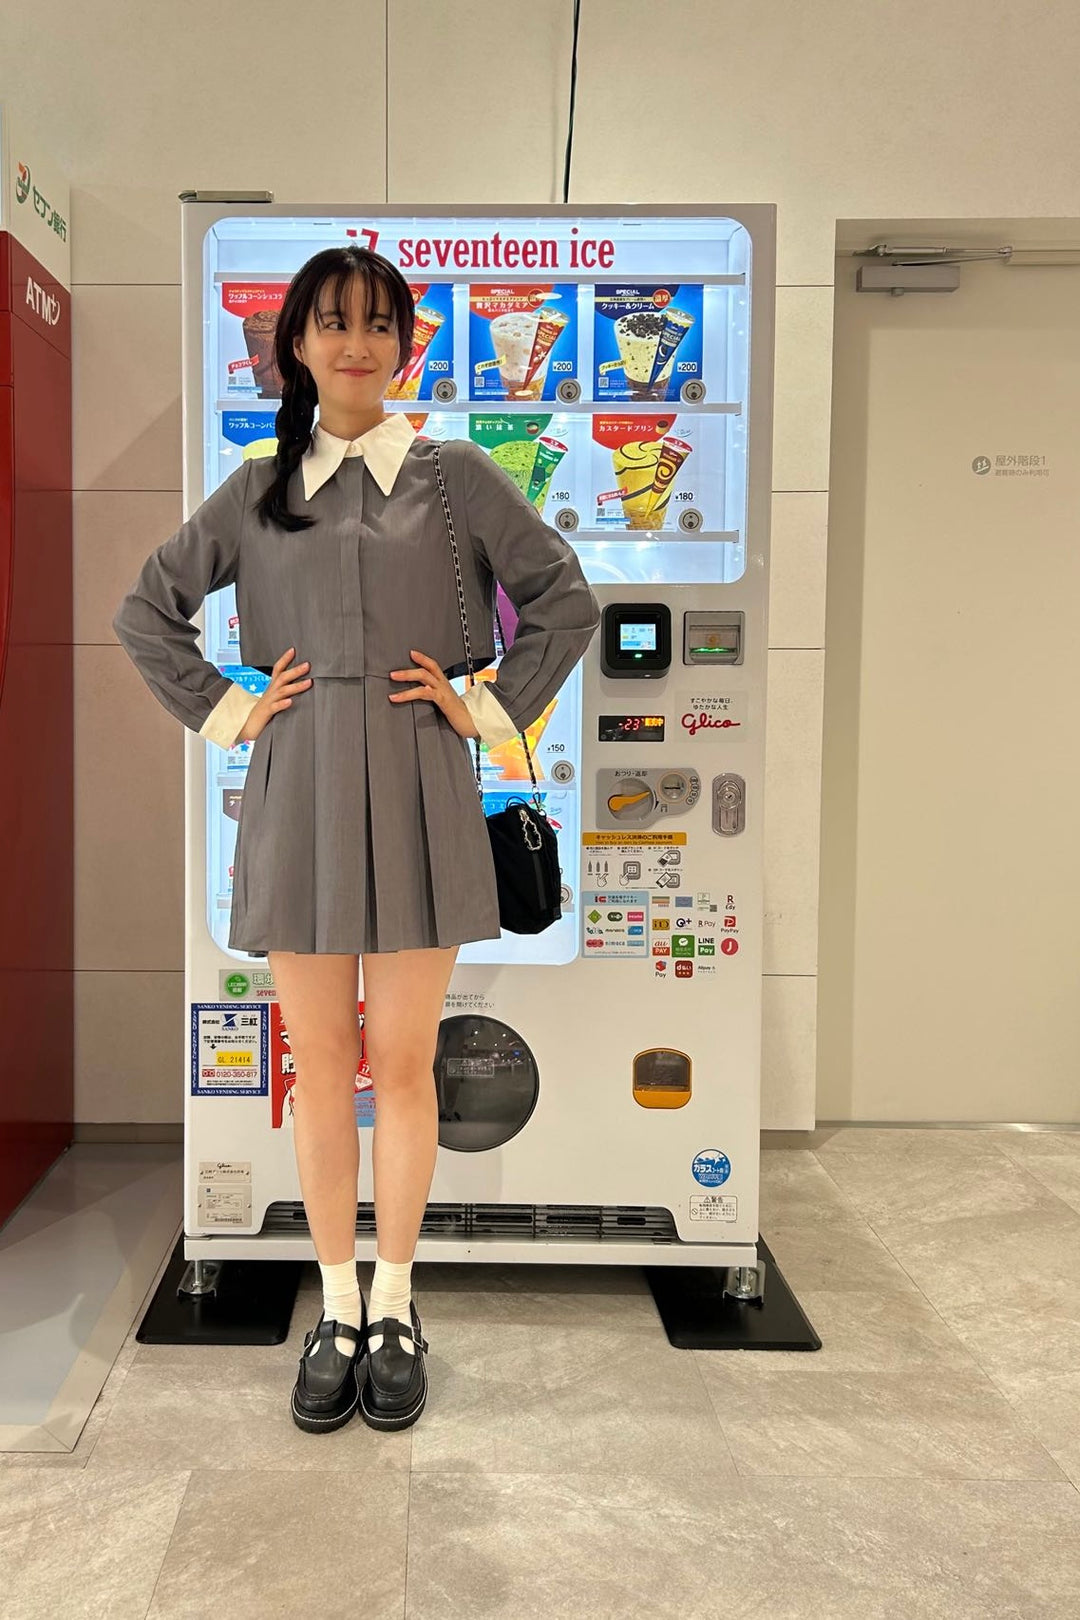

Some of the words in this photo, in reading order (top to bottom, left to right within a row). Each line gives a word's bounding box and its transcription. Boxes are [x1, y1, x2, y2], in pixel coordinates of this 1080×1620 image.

[33, 185, 66, 243] セブン銀行
[398, 231, 559, 268] seventeen
[570, 227, 615, 269] ice
[25, 276, 51, 325] ATM
[430, 362, 447, 370] ¥200
[554, 362, 572, 370] ¥200
[679, 363, 697, 371] ¥200
[995, 455, 1046, 466] 屋外階段1
[552, 492, 570, 500] ¥180
[675, 492, 693, 500] ¥180
[681, 712, 741, 736] Glico
[547, 744, 565, 752] ¥150
[704, 920, 716, 928] Pay
[655, 971, 666, 979] Pay
[241, 1017, 258, 1026] 三紅
